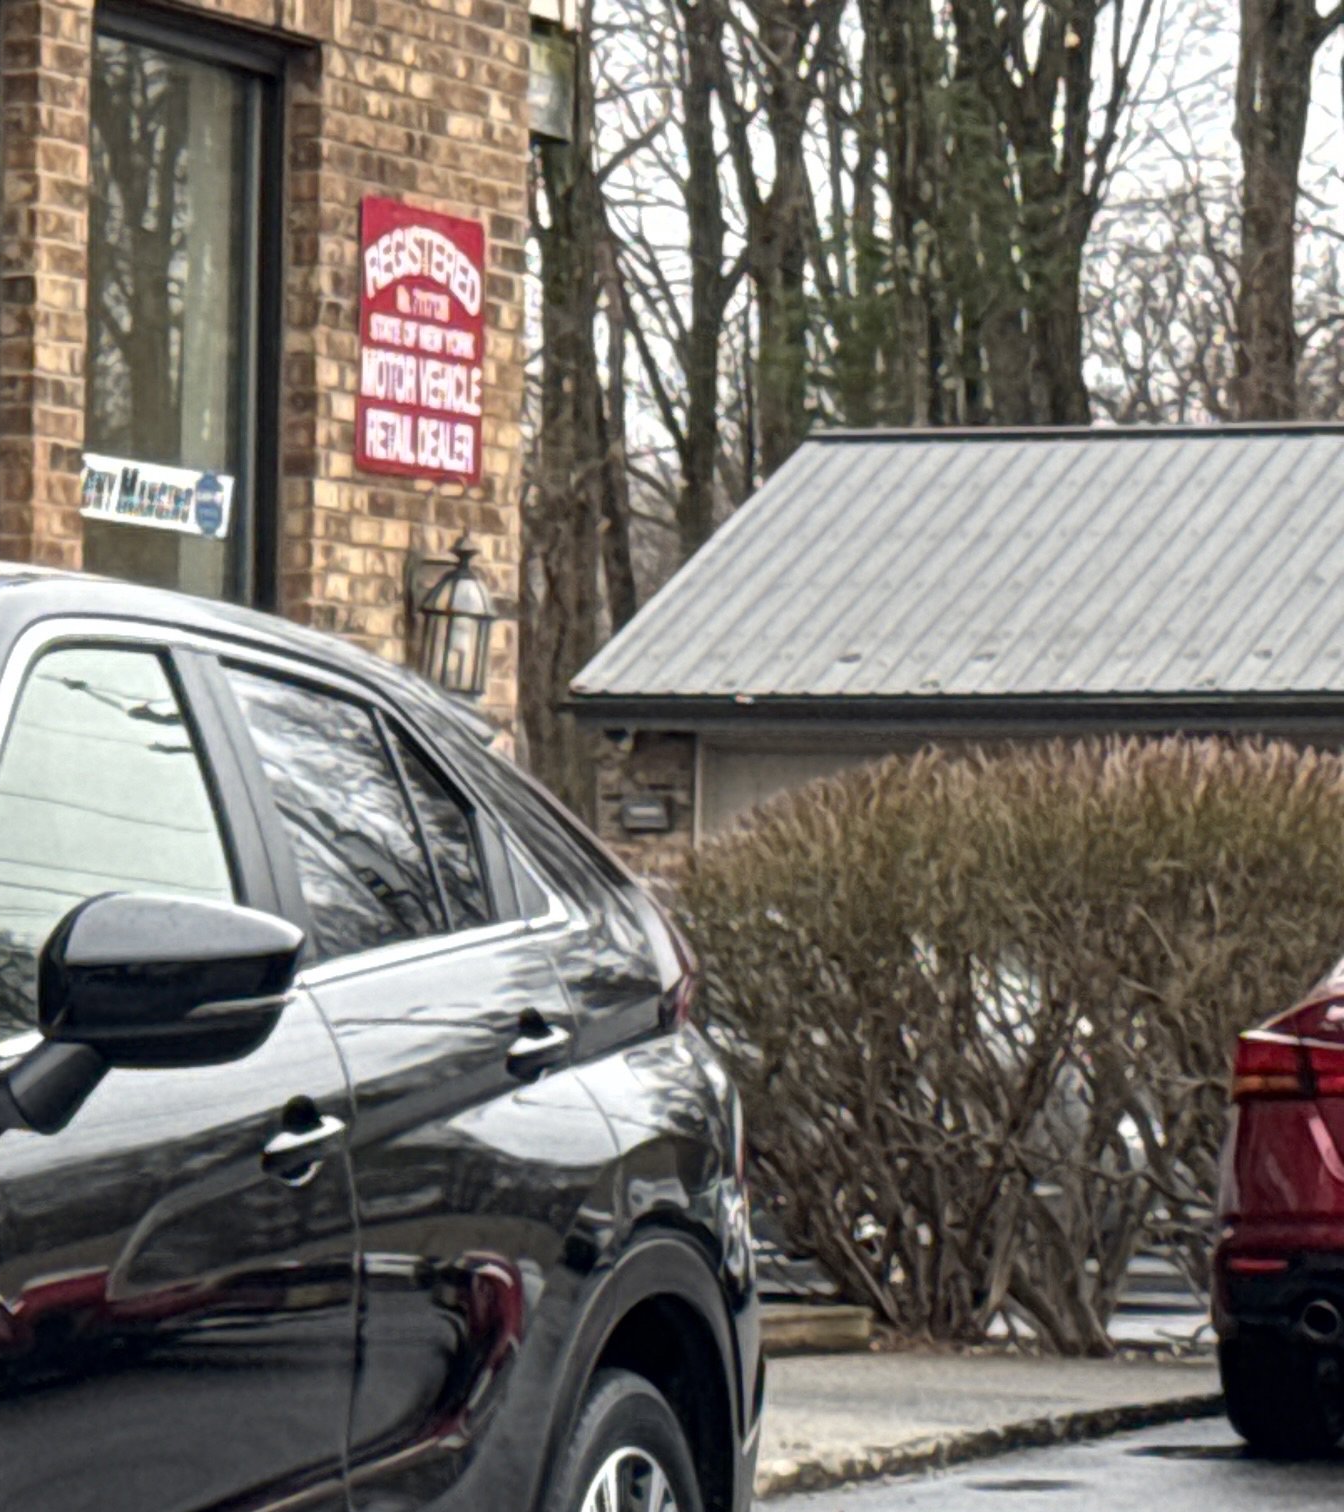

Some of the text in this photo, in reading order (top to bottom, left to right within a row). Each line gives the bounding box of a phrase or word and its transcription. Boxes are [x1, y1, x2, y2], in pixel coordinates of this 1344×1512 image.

[364, 225, 482, 317] REGISTERED
[362, 345, 482, 417] MOTOR VEHICLE
[365, 407, 475, 475] RETAIL DEALER
